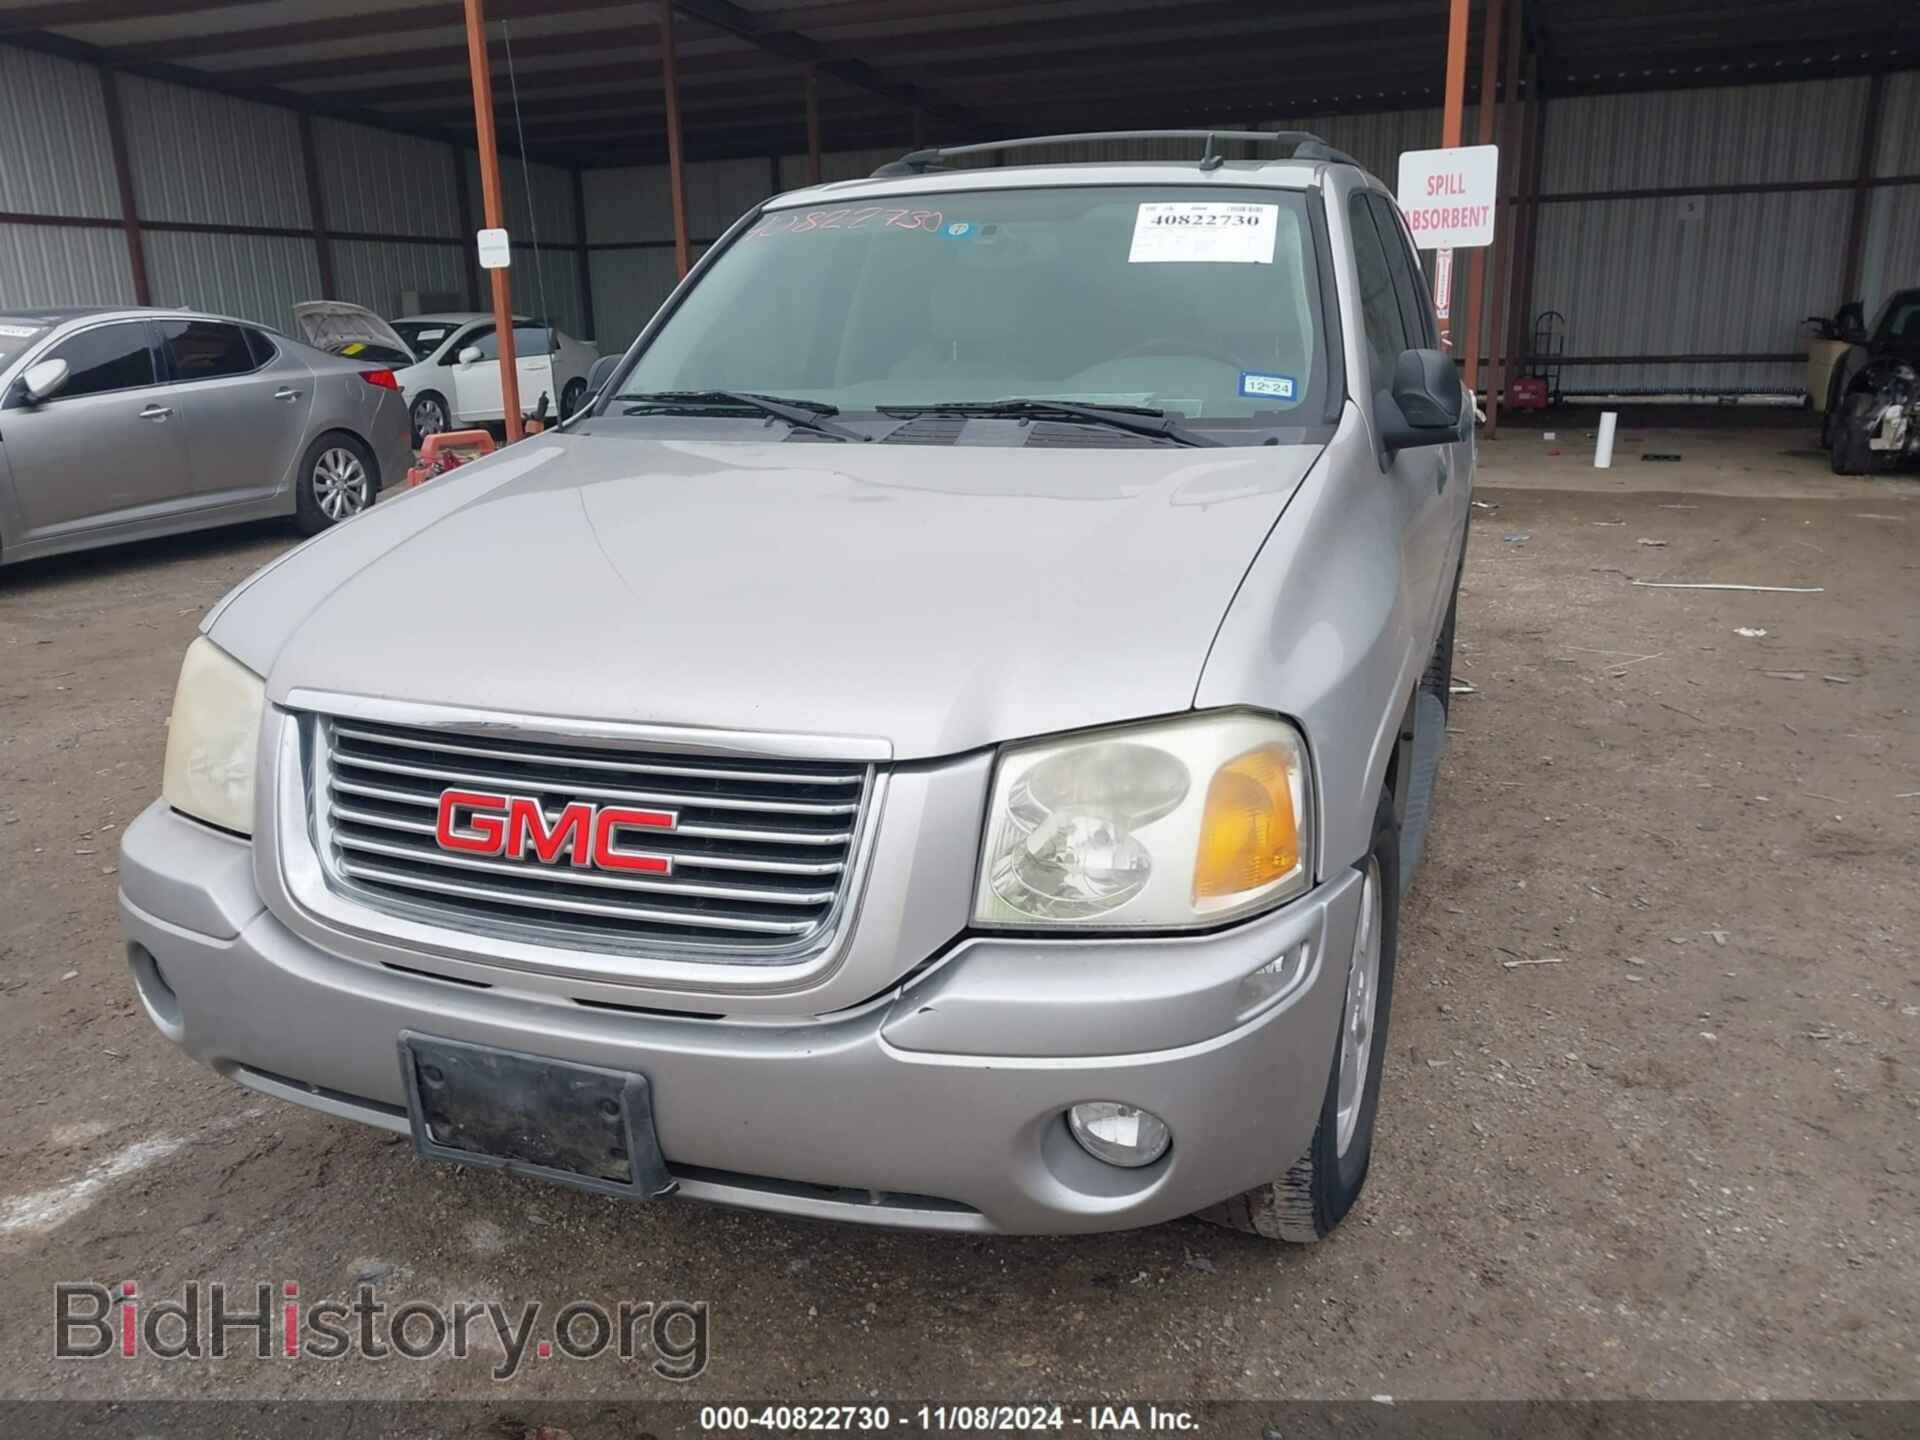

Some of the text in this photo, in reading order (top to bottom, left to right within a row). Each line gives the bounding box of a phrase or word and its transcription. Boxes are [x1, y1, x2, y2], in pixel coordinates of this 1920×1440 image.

[1427, 172, 1466, 196] SPILL
[1151, 214, 1260, 226] 40822730
[435, 788, 679, 877] GMC
